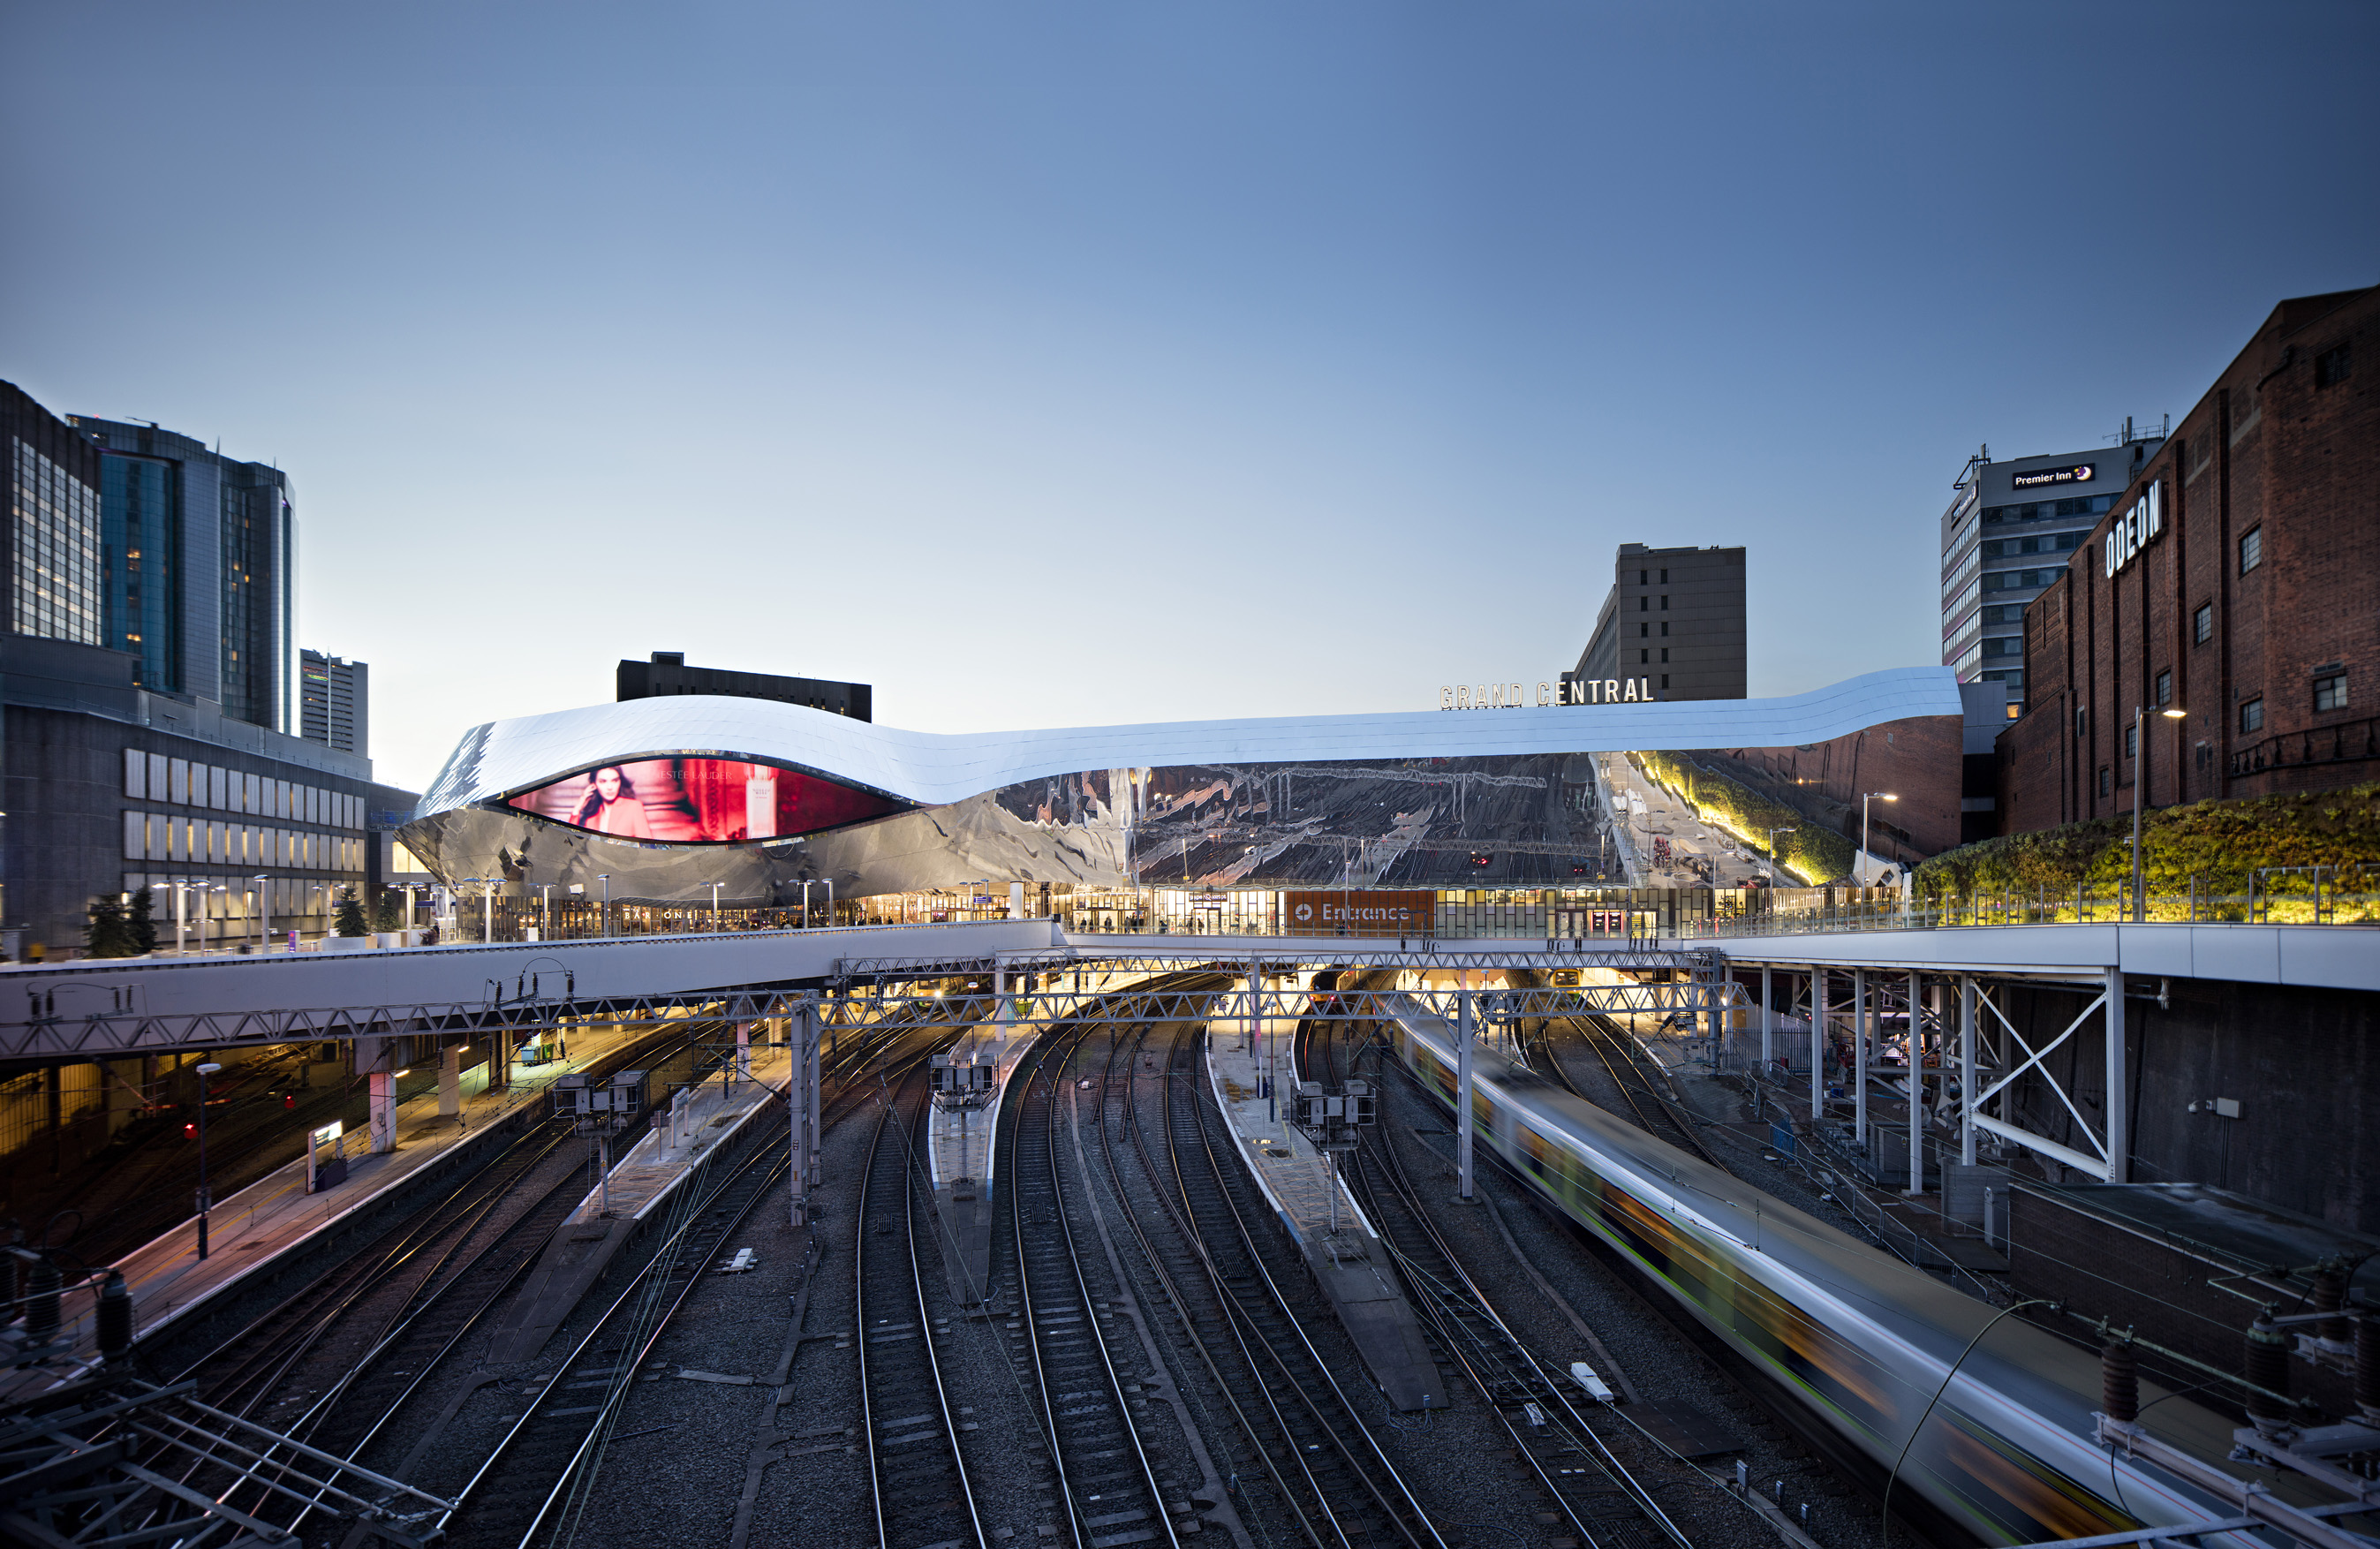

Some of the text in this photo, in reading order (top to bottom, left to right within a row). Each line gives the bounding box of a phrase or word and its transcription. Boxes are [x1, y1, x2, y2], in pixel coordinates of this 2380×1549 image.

[2015, 472, 2072, 486] Premier Inn
[2105, 480, 2161, 578] ODEON
[1439, 677, 1654, 709] GRAND CENTRAL
[692, 771, 732, 780] LAUDER
[1323, 903, 1409, 920] Entrance
